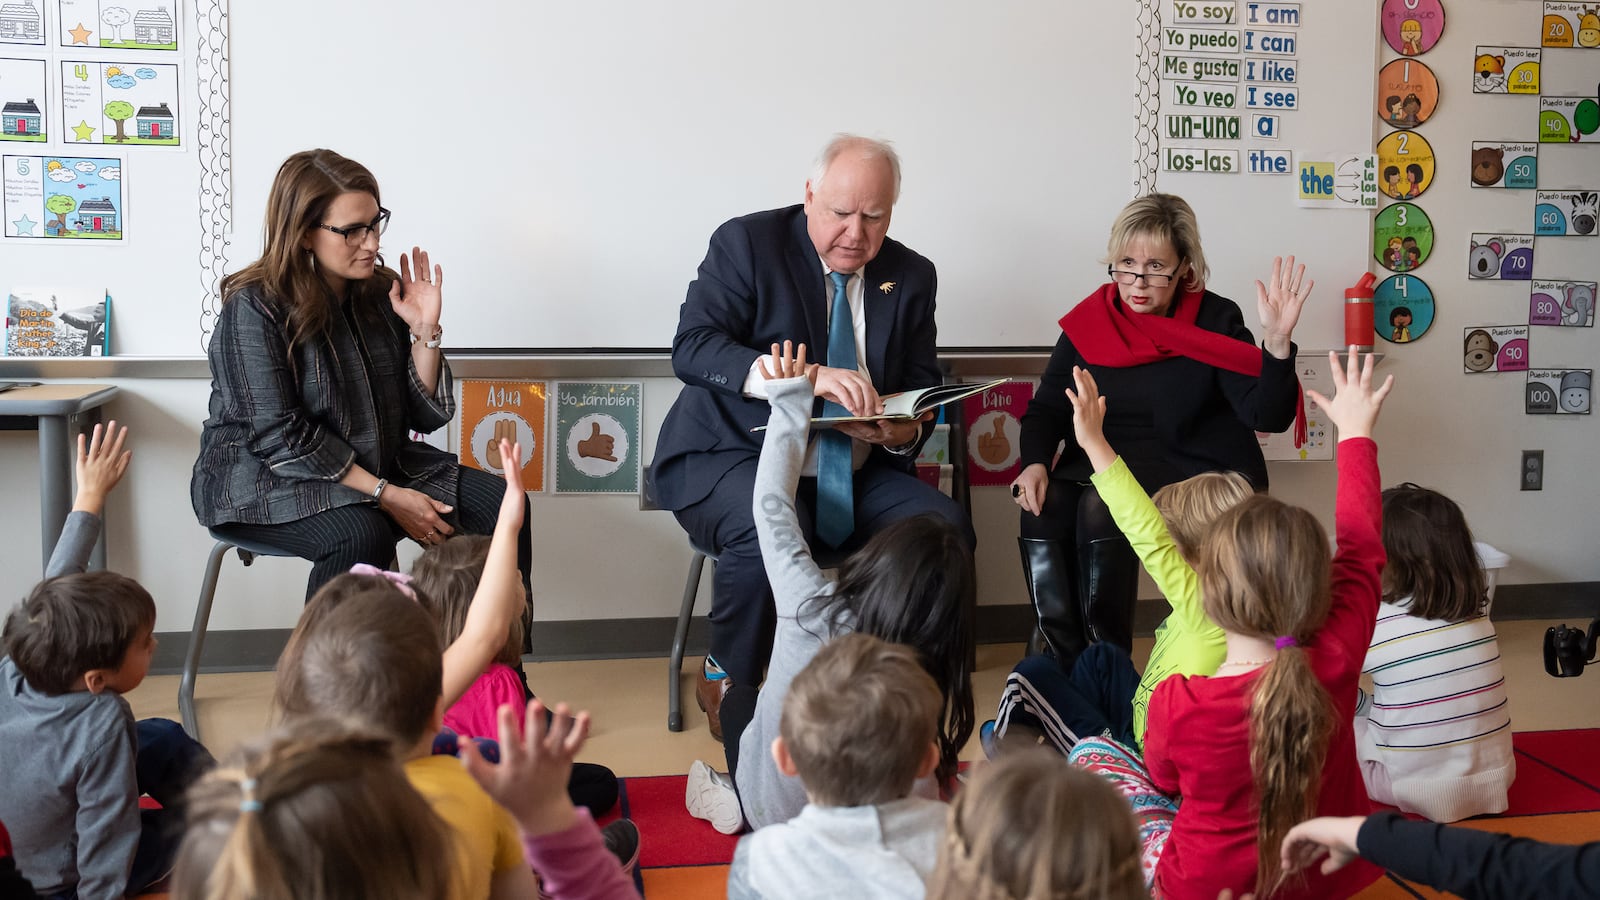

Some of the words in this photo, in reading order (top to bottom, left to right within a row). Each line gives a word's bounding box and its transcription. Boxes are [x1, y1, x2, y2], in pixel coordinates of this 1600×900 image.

[1174, 2, 1197, 18] Yo
[1203, 4, 1234, 24] soy
[1249, 4, 1259, 23] I
[1266, 8, 1299, 24] am
[1546, 3, 1567, 12] Puedo
[1568, 4, 1580, 12] leer
[1549, 24, 1565, 36] 20
[1165, 29, 1185, 45] Yo
[1189, 31, 1238, 50] puedo
[1245, 31, 1254, 50] I
[1261, 36, 1295, 53] can
[1504, 49, 1525, 57] Puedo
[75, 64, 89, 82] 4
[1164, 56, 1188, 74] Me
[1193, 59, 1238, 80] gusta
[1246, 62, 1255, 80] I
[1262, 61, 1295, 82] like
[1518, 70, 1533, 83] 30
[1175, 85, 1197, 105] Yo
[1204, 91, 1235, 108] veo
[1248, 87, 1257, 105] I
[1264, 92, 1296, 108] see
[1542, 99, 1563, 107] Puedo
[1168, 115, 1240, 139] un-una
[1257, 116, 1273, 137] a
[1546, 119, 1562, 132] 40
[1397, 133, 1409, 155] 2
[1500, 144, 1521, 152] Puedo
[1167, 149, 1232, 171] los-las
[1250, 150, 1287, 172] the
[1363, 156, 1375, 169] el
[17, 158, 31, 176] 5
[1514, 165, 1530, 177] 50
[1300, 166, 1334, 195] the
[1363, 169, 1375, 182] la
[1361, 180, 1377, 193] los
[1361, 194, 1377, 206] las
[1396, 206, 1408, 226] 3
[1542, 212, 1558, 225] 60
[1511, 256, 1526, 269] 70
[1394, 277, 1407, 298] 4
[1534, 282, 1555, 290] Puedo
[39, 308, 53, 318] de
[1537, 302, 1553, 314] 80
[19, 319, 55, 328] Martin
[18, 329, 54, 338] Luther
[1492, 328, 1512, 336] Puedo
[1513, 328, 1526, 336] leer
[1506, 347, 1522, 360] 90
[1529, 371, 1550, 379] Puedo
[486, 385, 522, 408] Agua
[561, 393, 578, 406] Yo
[582, 391, 636, 407] también
[982, 390, 1013, 409] Baño
[1530, 391, 1550, 403] 100
